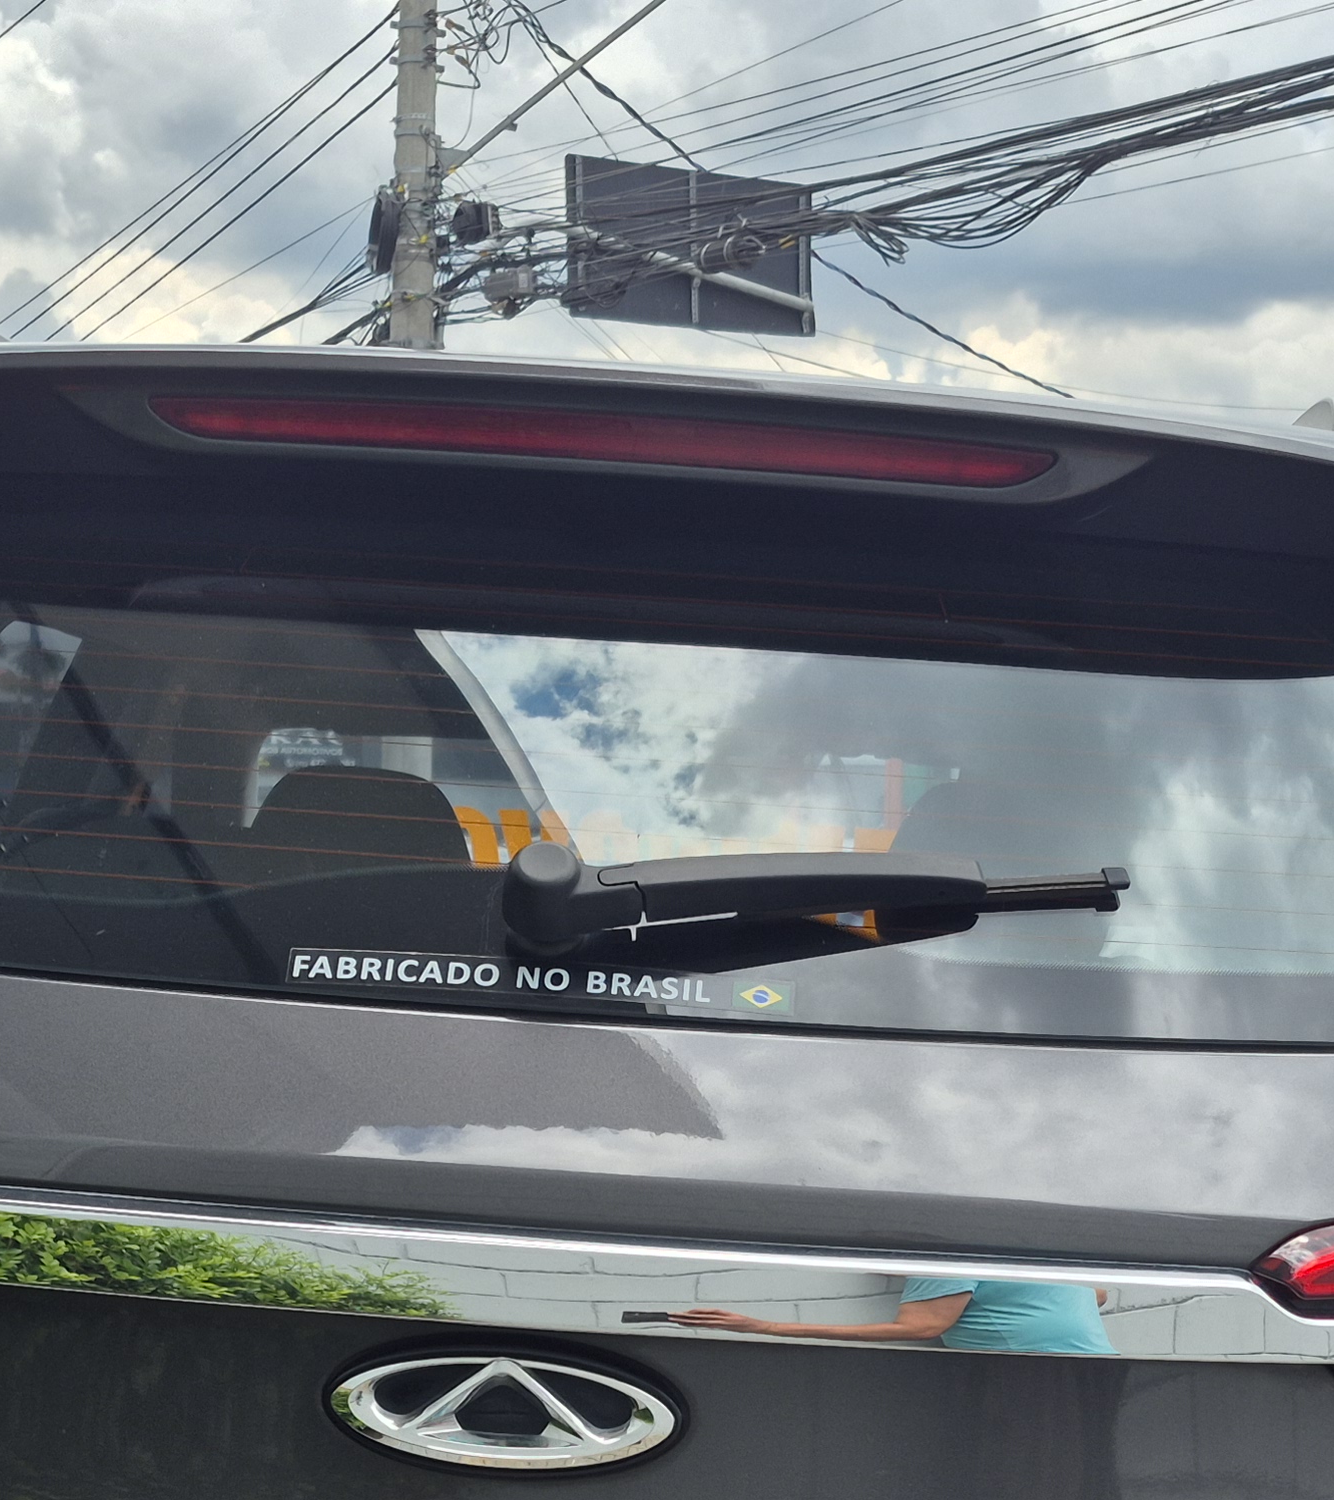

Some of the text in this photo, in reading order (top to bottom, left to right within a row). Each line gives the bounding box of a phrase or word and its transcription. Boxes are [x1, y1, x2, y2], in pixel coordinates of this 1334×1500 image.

[291, 954, 711, 1004] FABRICADO NO BRASIL
